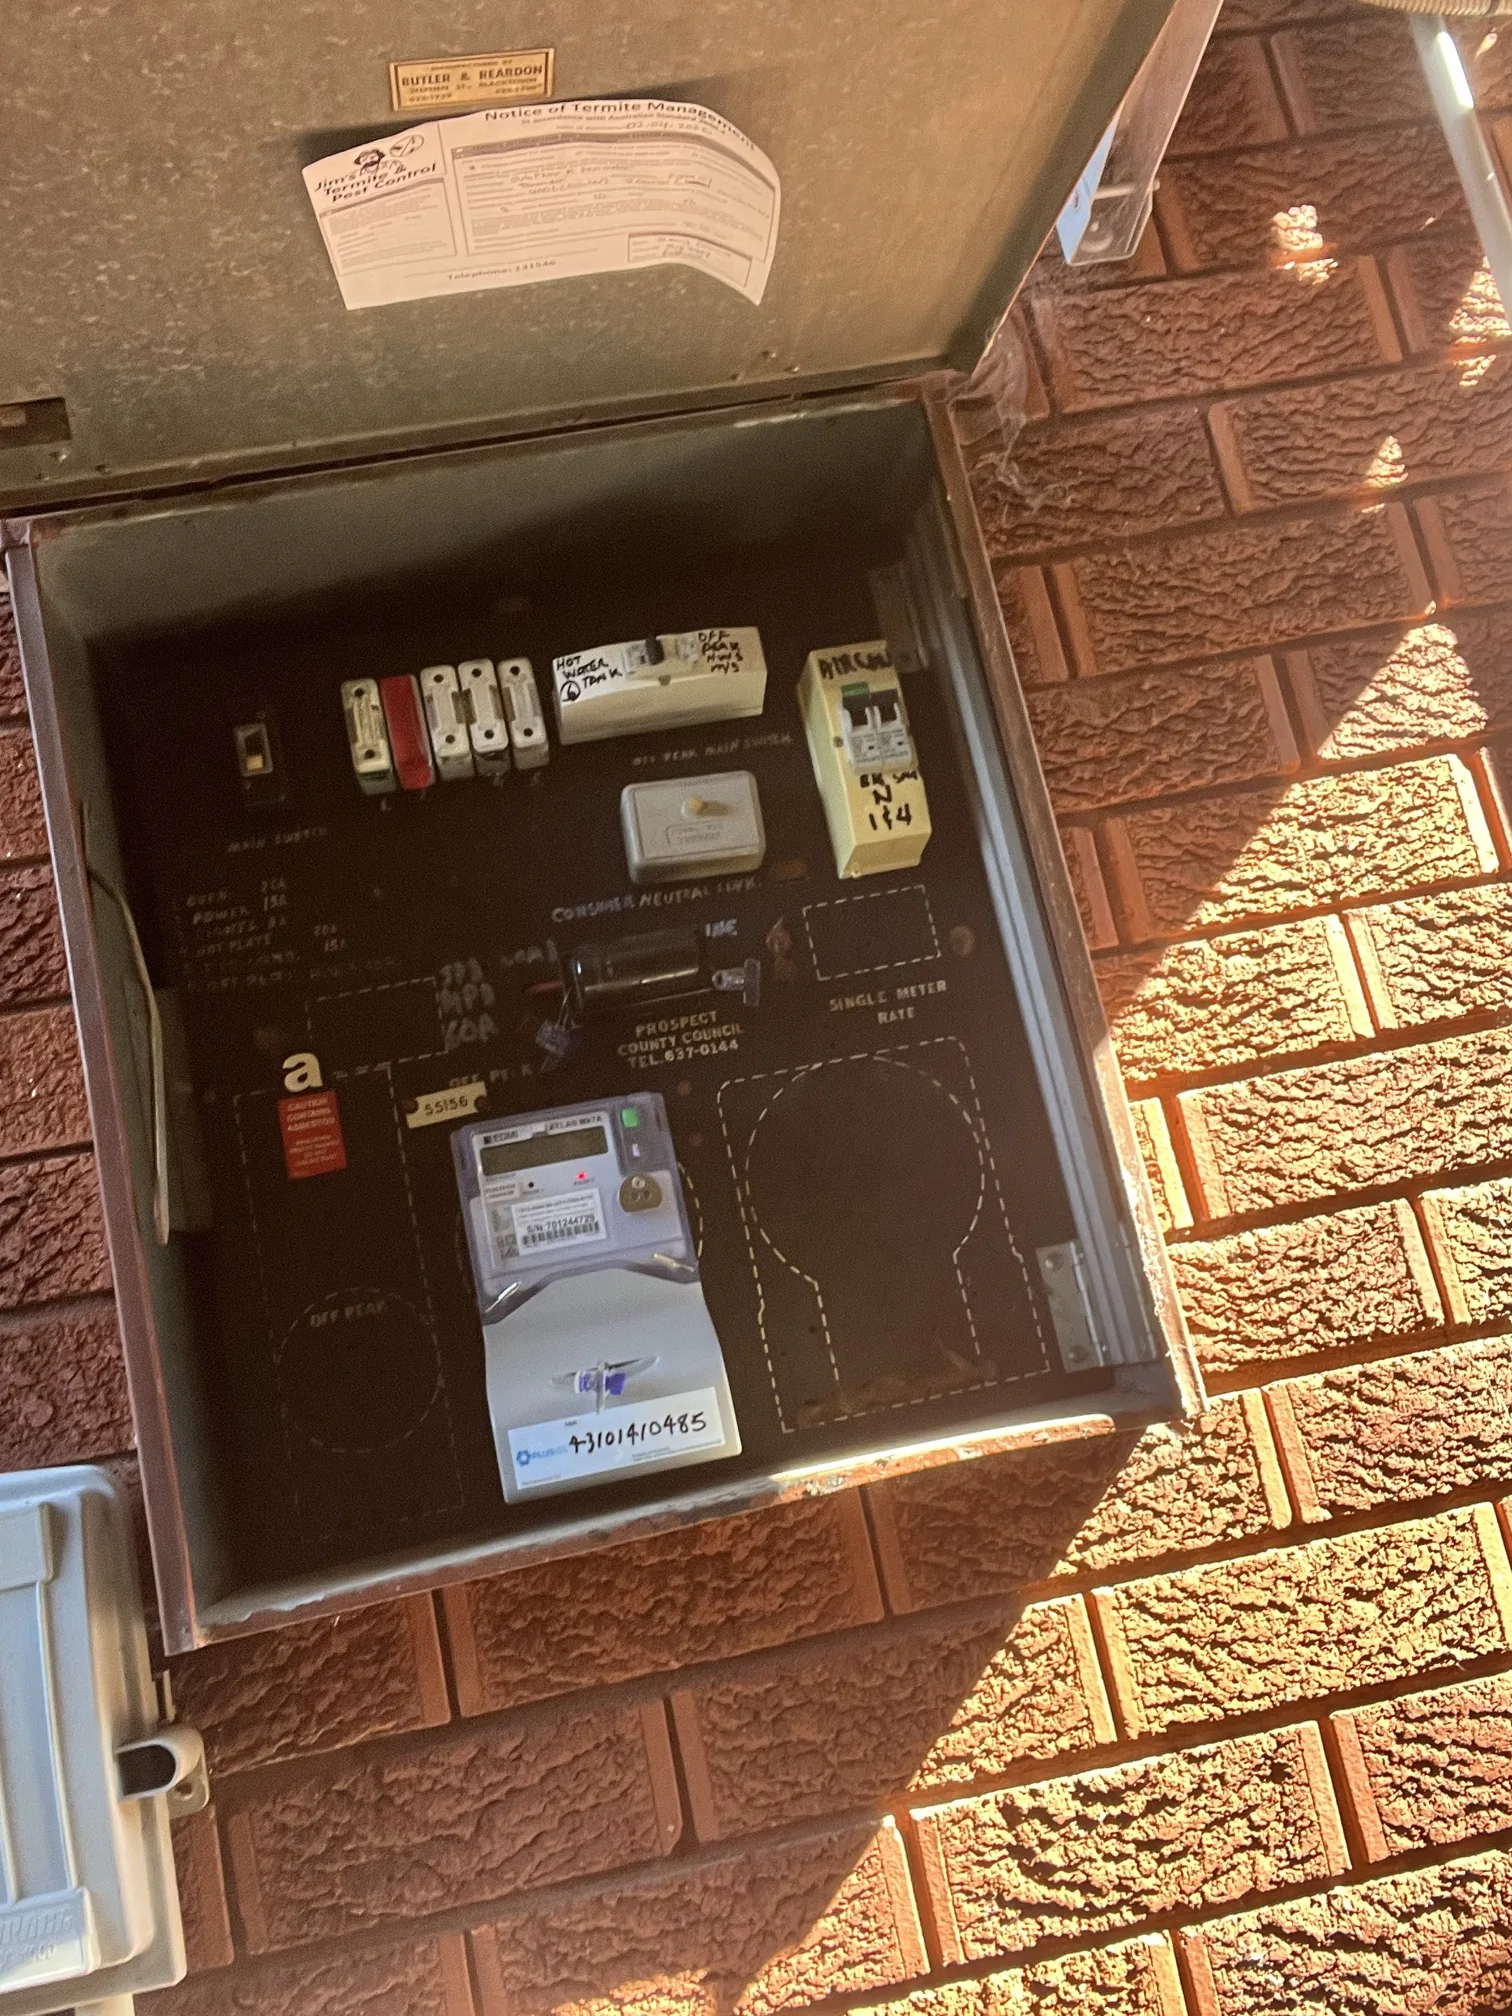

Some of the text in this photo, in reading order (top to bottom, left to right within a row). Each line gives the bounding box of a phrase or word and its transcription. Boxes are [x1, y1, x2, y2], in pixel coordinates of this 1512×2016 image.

[401, 65, 543, 87] BUTLER & REARDON
[485, 108, 543, 121] Notice
[548, 103, 566, 113] of
[573, 101, 641, 113] Termite
[647, 101, 756, 151] Management
[315, 172, 356, 193] Jim's
[323, 163, 408, 197] Termite &
[332, 162, 437, 204] Pest Control
[697, 628, 731, 643] OFF
[556, 655, 581, 672] HOT
[582, 668, 623, 690] TANK
[828, 978, 948, 1013] SINGLE METER
[634, 1009, 719, 1039] PROSPECT
[876, 1005, 916, 1026] RATE
[616, 1022, 744, 1058] COUNTY COUNCIL
[282, 1052, 324, 1093] a
[424, 1095, 468, 1117] 55156
[568, 1411, 707, 1454] 43101410485
